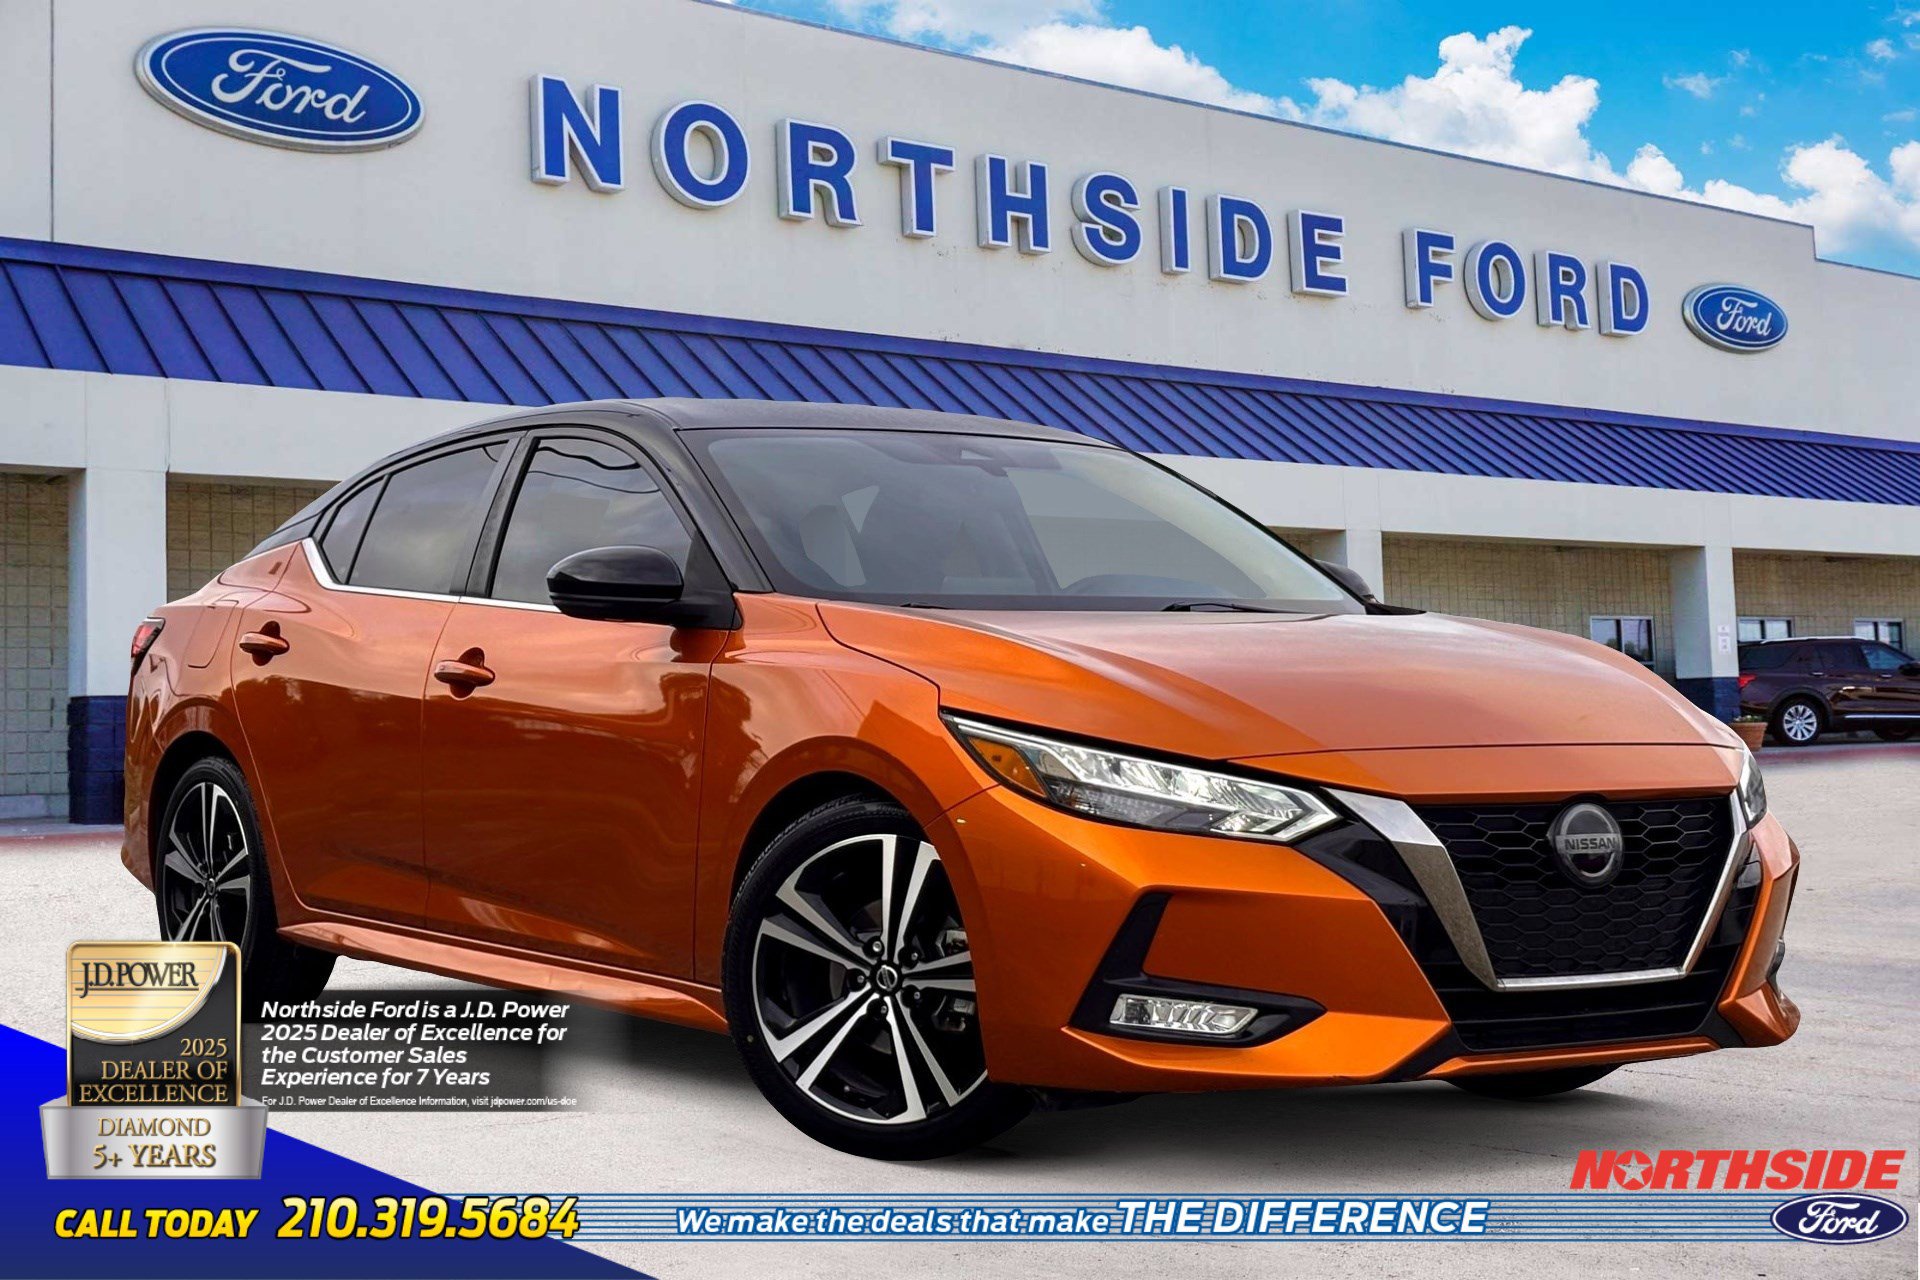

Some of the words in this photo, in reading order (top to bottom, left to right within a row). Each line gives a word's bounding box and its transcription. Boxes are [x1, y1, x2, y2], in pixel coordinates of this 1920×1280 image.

[211, 48, 370, 123] Ford
[531, 74, 1347, 298] NORTHSIDE
[1403, 228, 1650, 337] FORD
[1716, 296, 1773, 337] Ford
[1565, 838, 1615, 850] NISSAN
